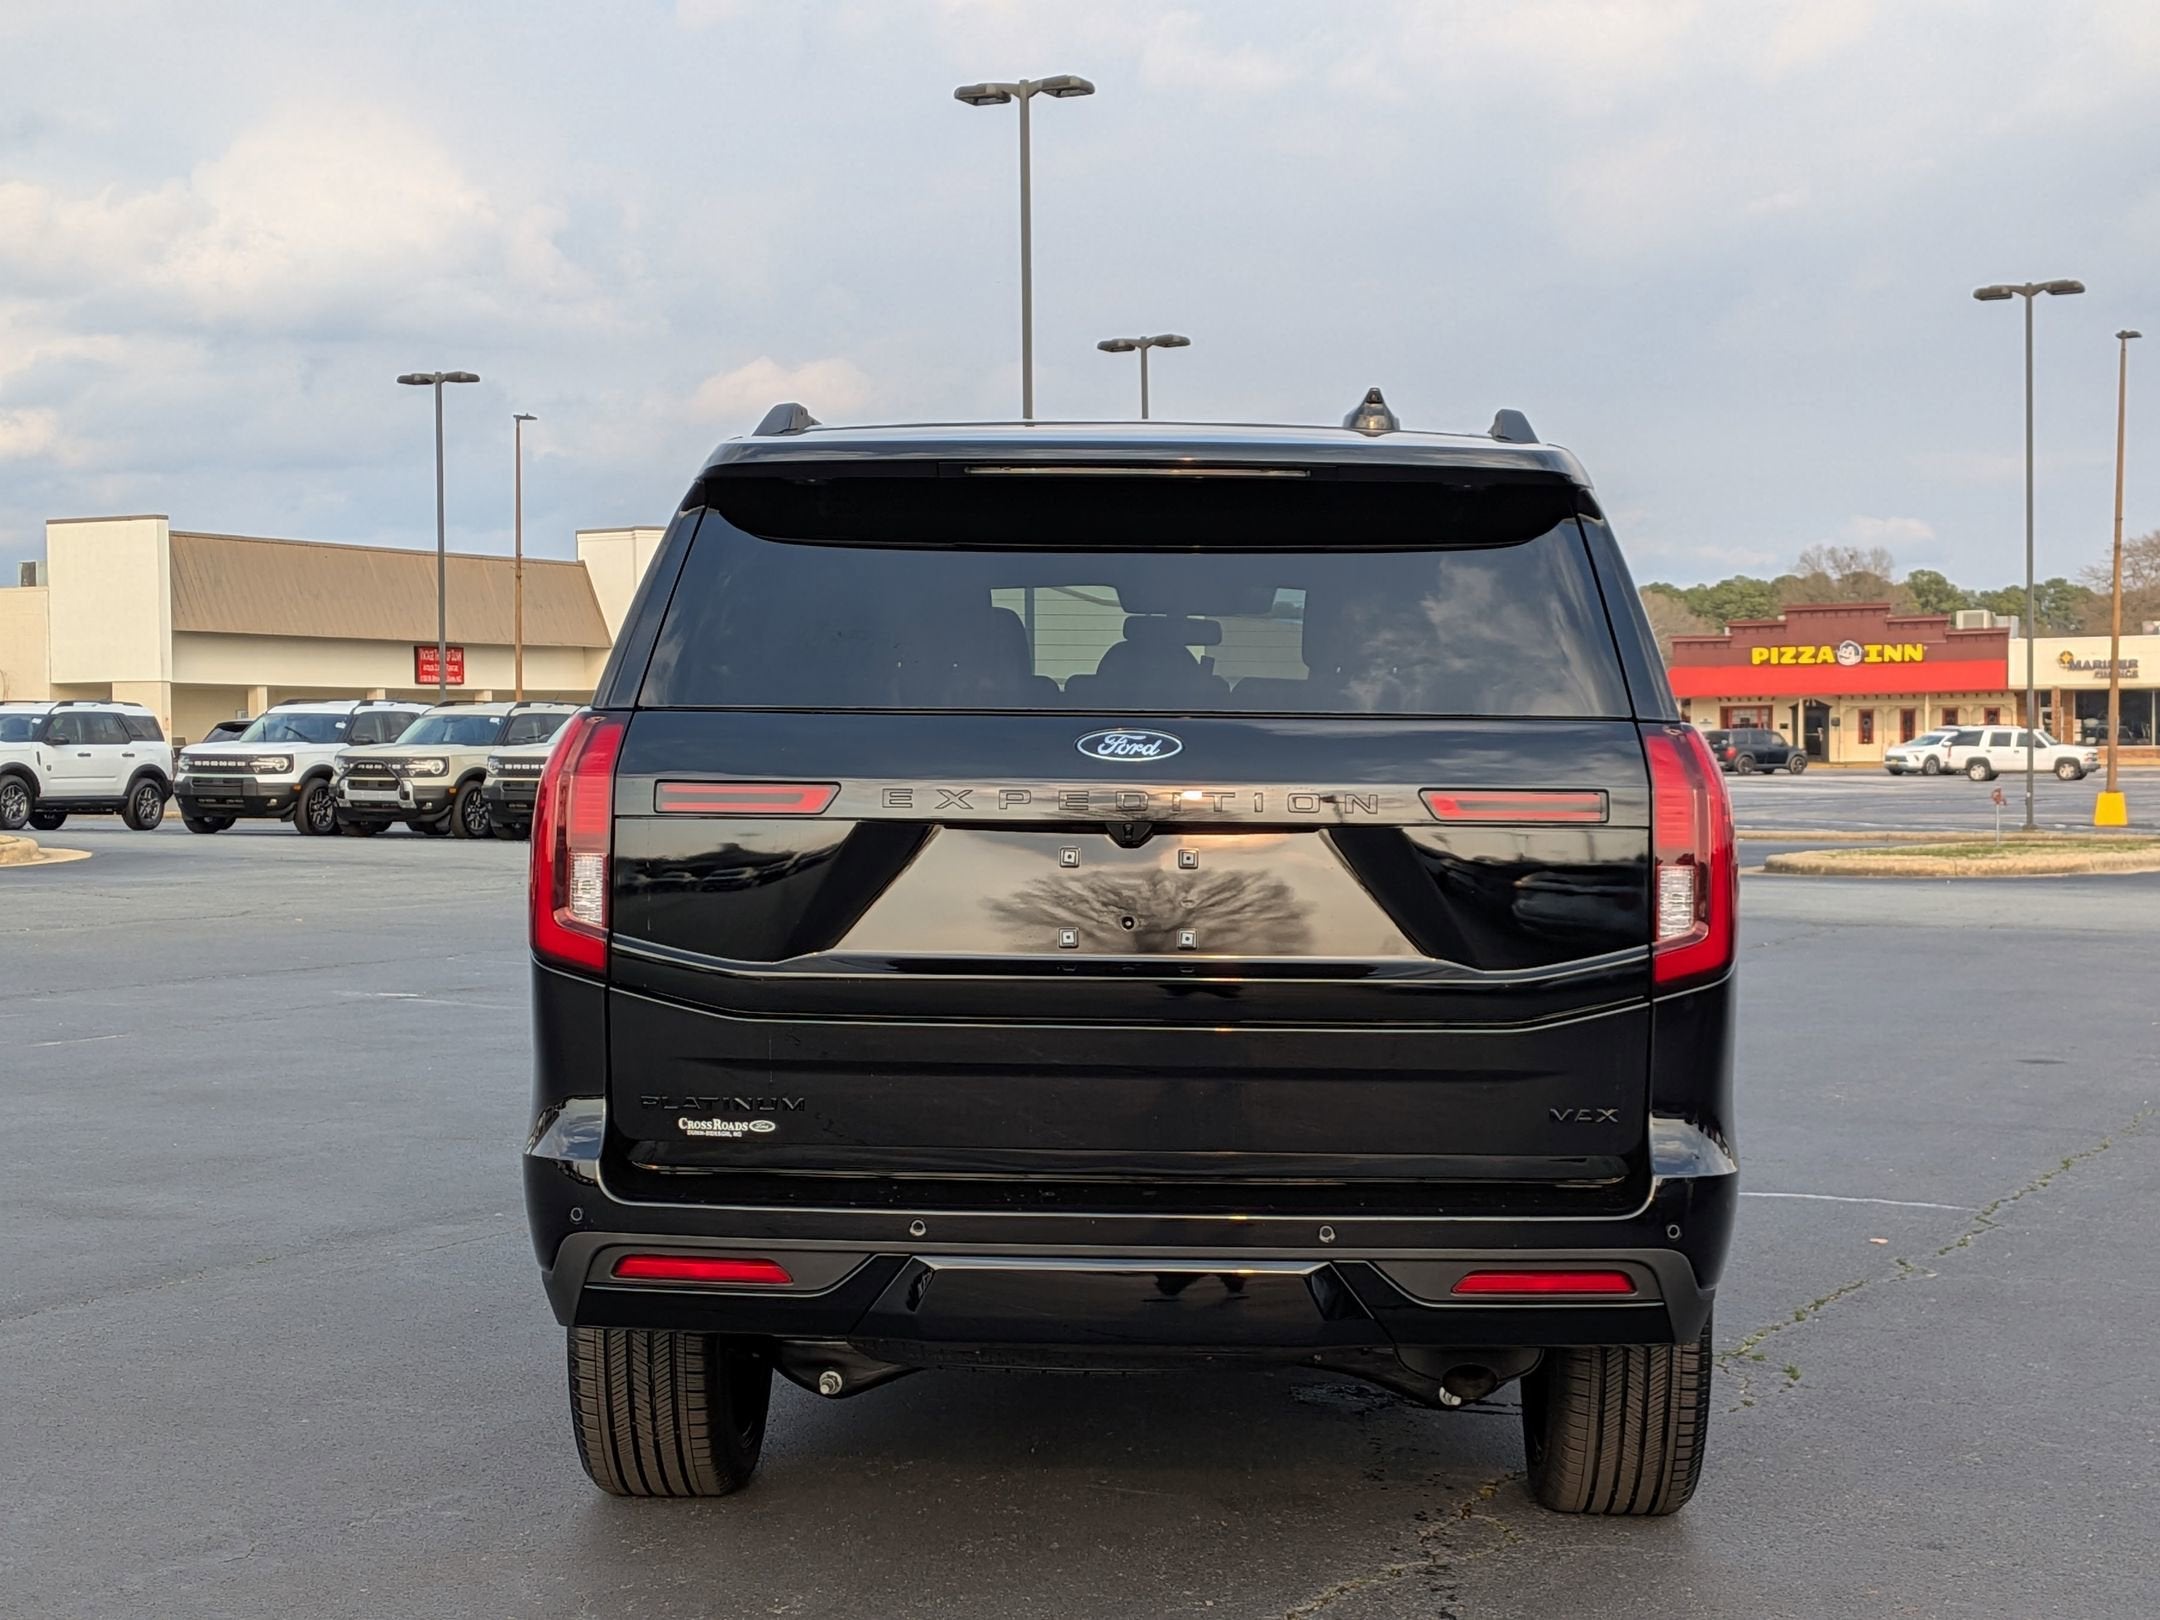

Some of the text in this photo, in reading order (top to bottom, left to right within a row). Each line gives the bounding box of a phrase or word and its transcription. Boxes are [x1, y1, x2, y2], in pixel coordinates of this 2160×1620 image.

[1751, 643, 1923, 665] PIZZA INN
[2068, 659, 2139, 671] MARIER
[1097, 734, 1161, 757] Ford
[881, 787, 1379, 815] EXPEDITION
[640, 1095, 806, 1112] PLATINUM
